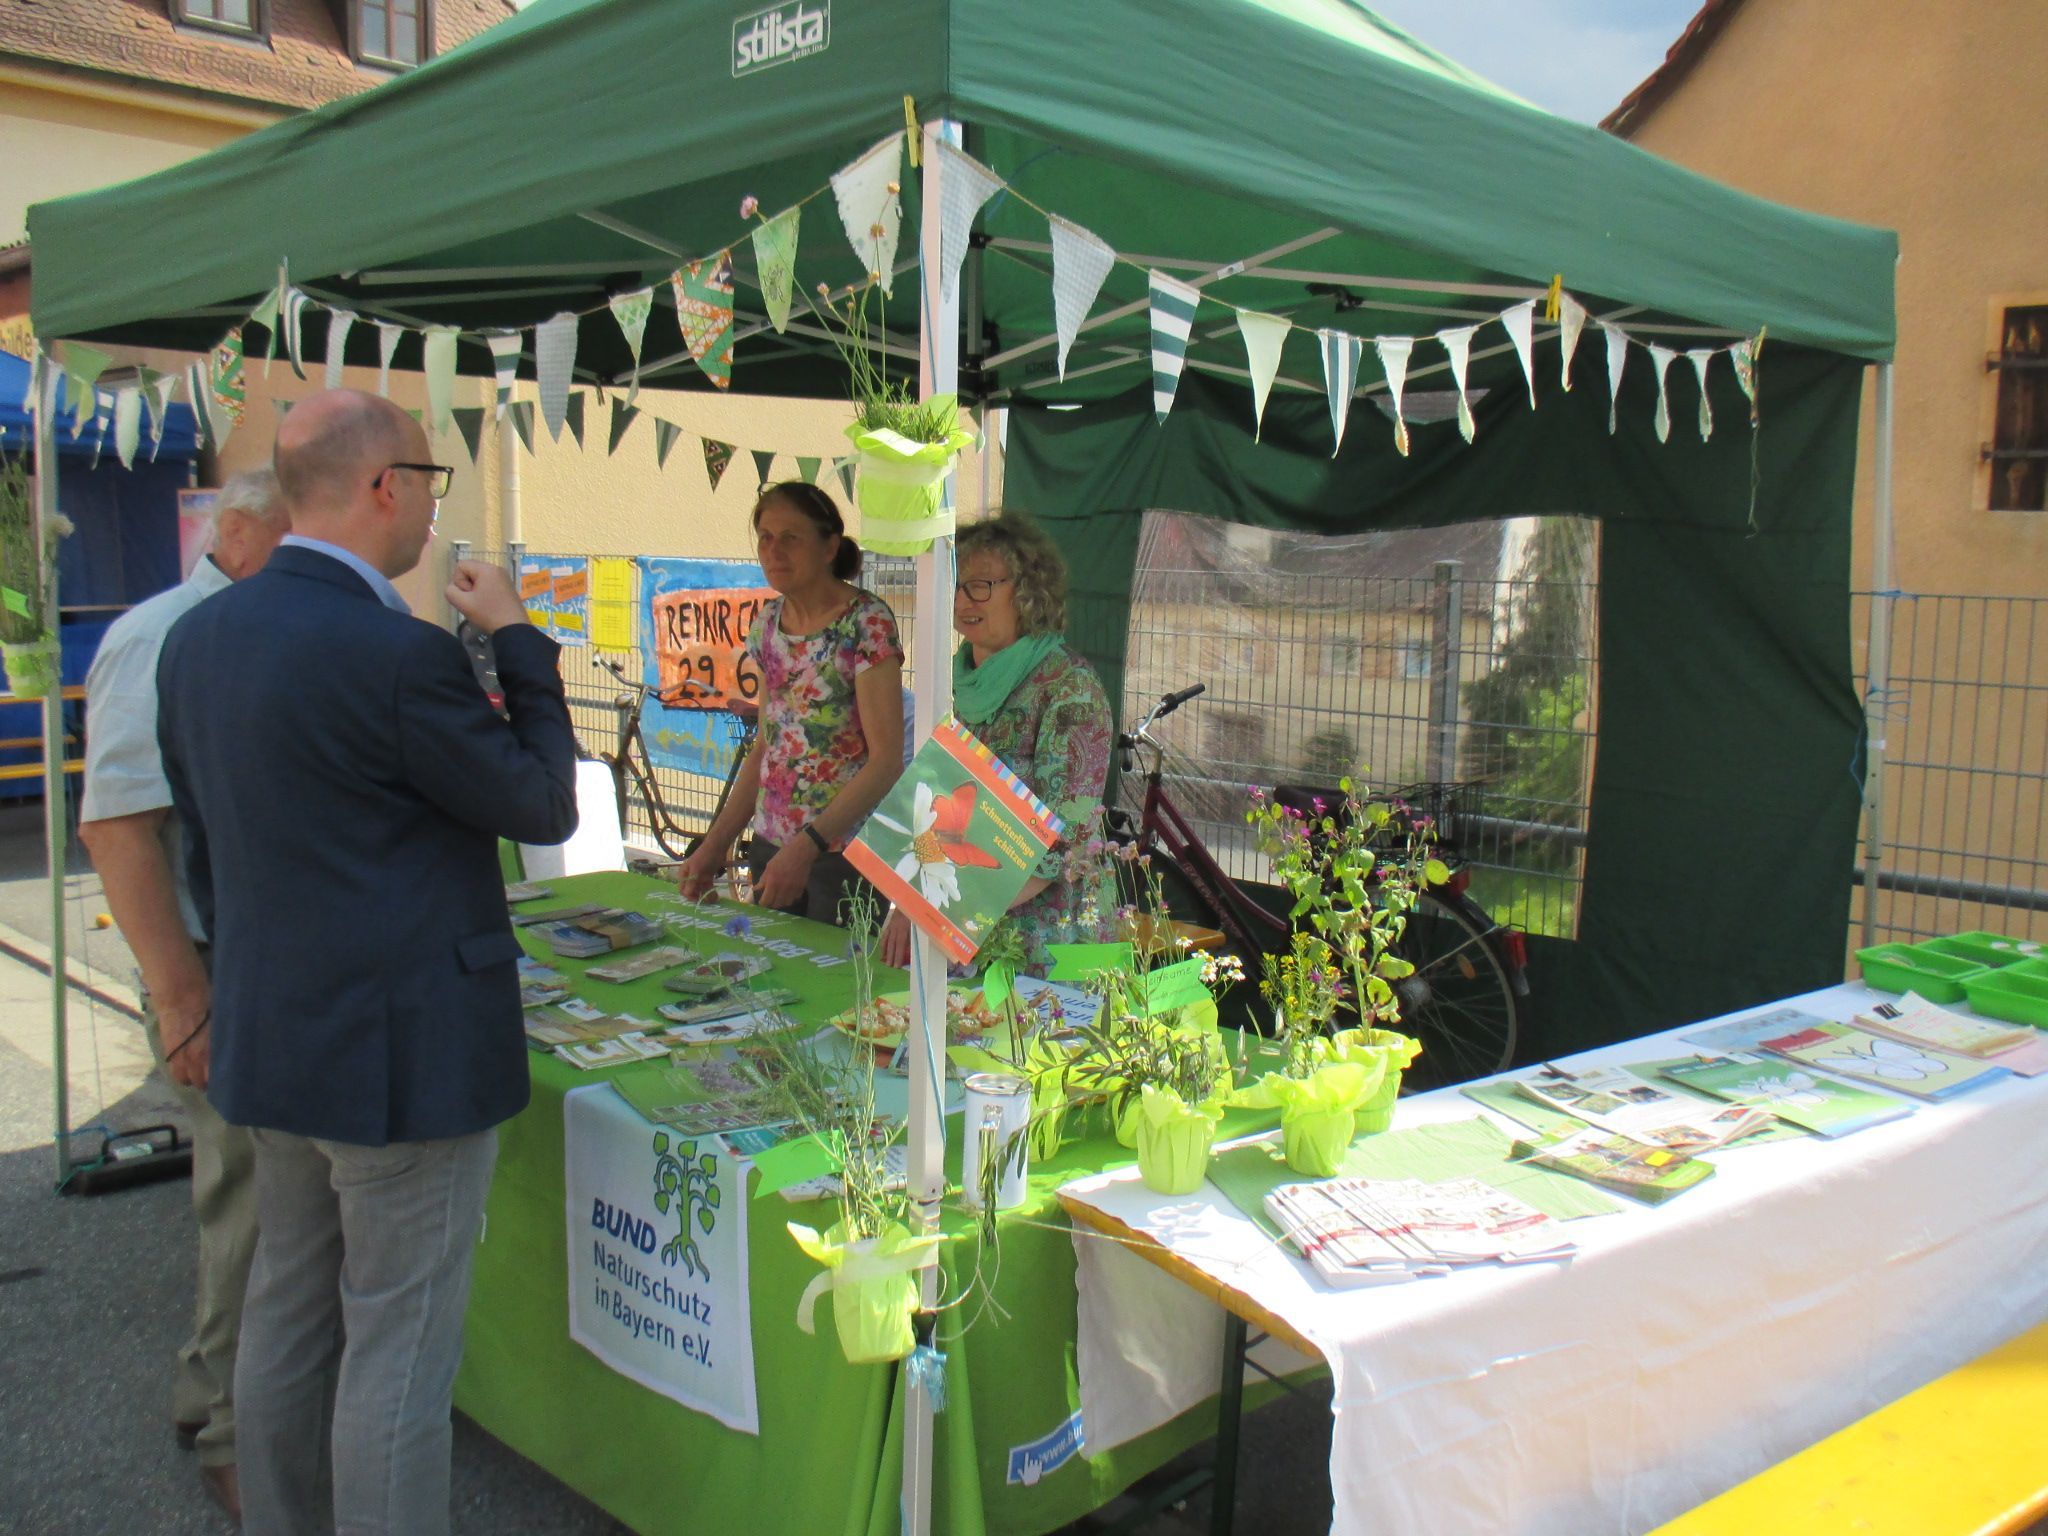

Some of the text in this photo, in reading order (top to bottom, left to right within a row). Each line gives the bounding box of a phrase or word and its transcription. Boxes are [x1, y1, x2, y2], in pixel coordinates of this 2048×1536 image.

[737, 3, 823, 69] stilista
[665, 601, 734, 650] REPAIR
[736, 651, 759, 699] 6
[980, 801, 1034, 858] Schmetterlinge
[993, 836, 1027, 870] schützen
[592, 1198, 657, 1254] BUND
[593, 1240, 712, 1326] Naturschutz
[595, 1277, 713, 1368] in Bayern e.V.
